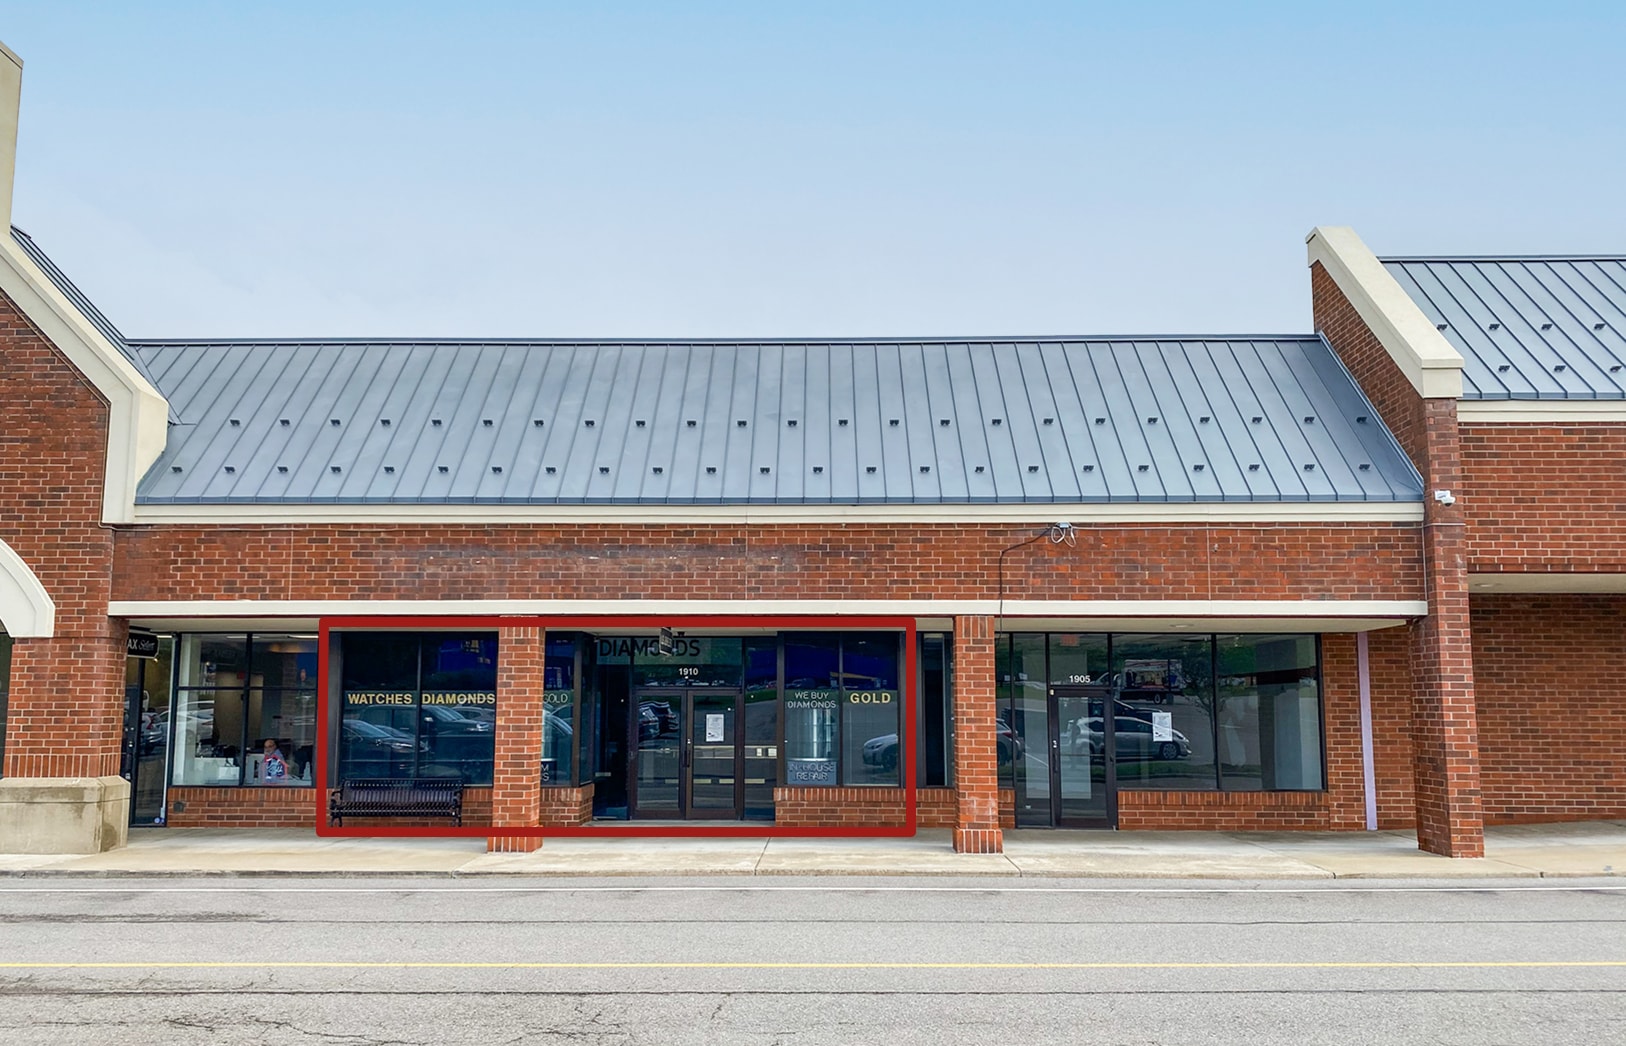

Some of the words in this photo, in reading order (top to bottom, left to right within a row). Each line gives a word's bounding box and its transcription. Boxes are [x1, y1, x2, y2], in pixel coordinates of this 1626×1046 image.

[126, 638, 138, 650] AX
[599, 639, 701, 657] DIAMODS
[678, 667, 699, 676] 1910
[1068, 674, 1091, 683] 1905
[347, 693, 413, 705] WATCHES
[422, 693, 496, 705] DIAMONDS
[794, 691, 809, 700] WE
[811, 691, 830, 700] BUY
[850, 692, 892, 704] GOLD
[787, 700, 837, 709] DIAMONDS
